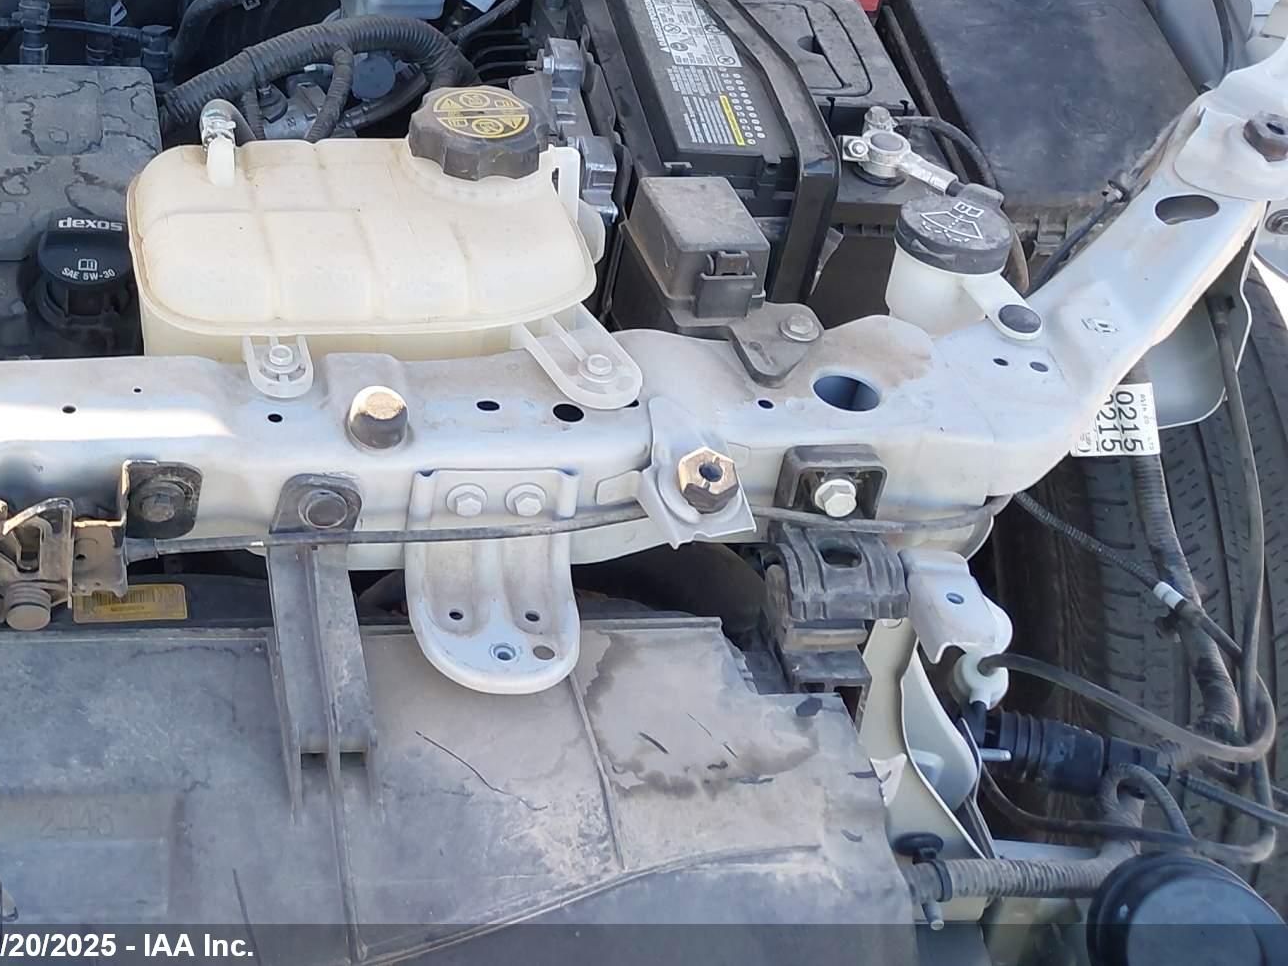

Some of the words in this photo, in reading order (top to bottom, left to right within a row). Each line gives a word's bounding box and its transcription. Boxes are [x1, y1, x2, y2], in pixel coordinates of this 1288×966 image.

[58, 217, 123, 232] dexos
[62, 267, 79, 280] SAE
[83, 268, 116, 281] 5W-30
[1116, 391, 1144, 452] 0215
